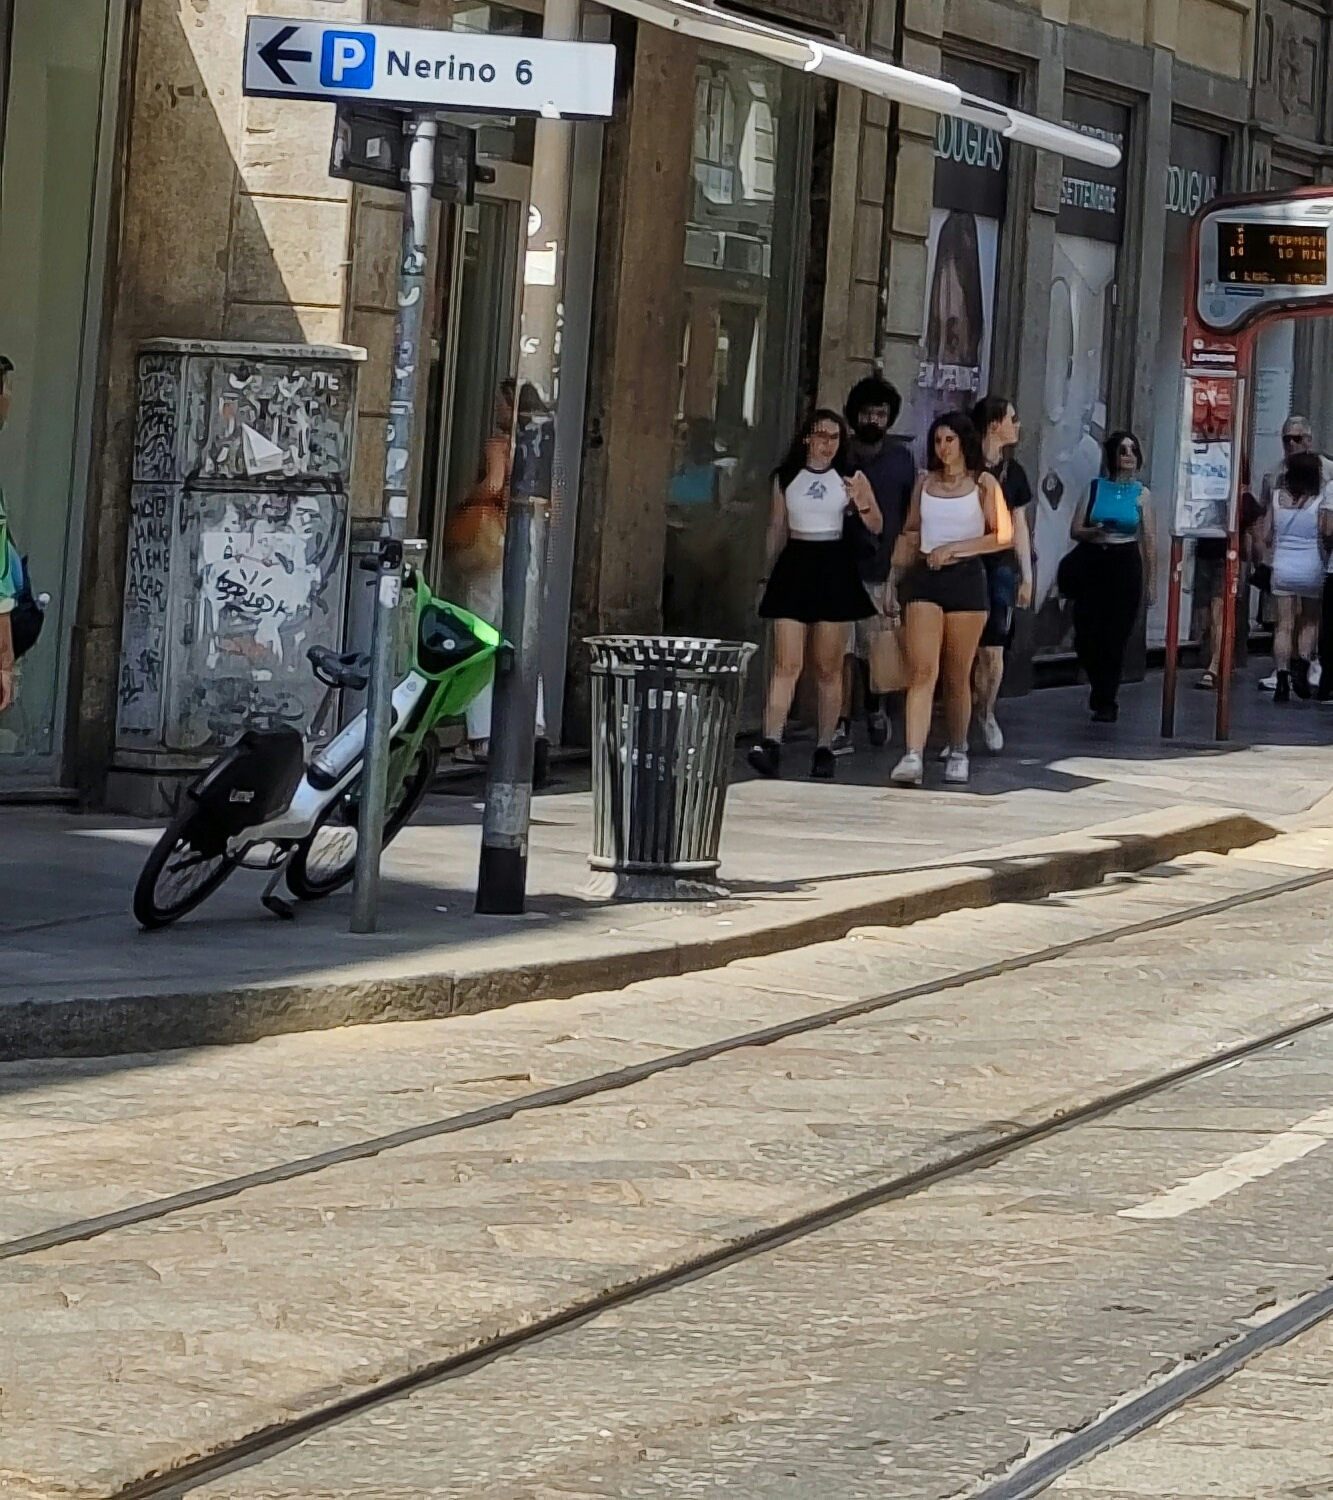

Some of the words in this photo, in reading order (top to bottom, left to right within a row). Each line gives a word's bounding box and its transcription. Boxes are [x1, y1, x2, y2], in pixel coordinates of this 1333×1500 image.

[331, 37, 367, 82] P
[387, 50, 496, 83] Nerino
[516, 59, 533, 85] 6
[935, 115, 1002, 171] OUGLAS
